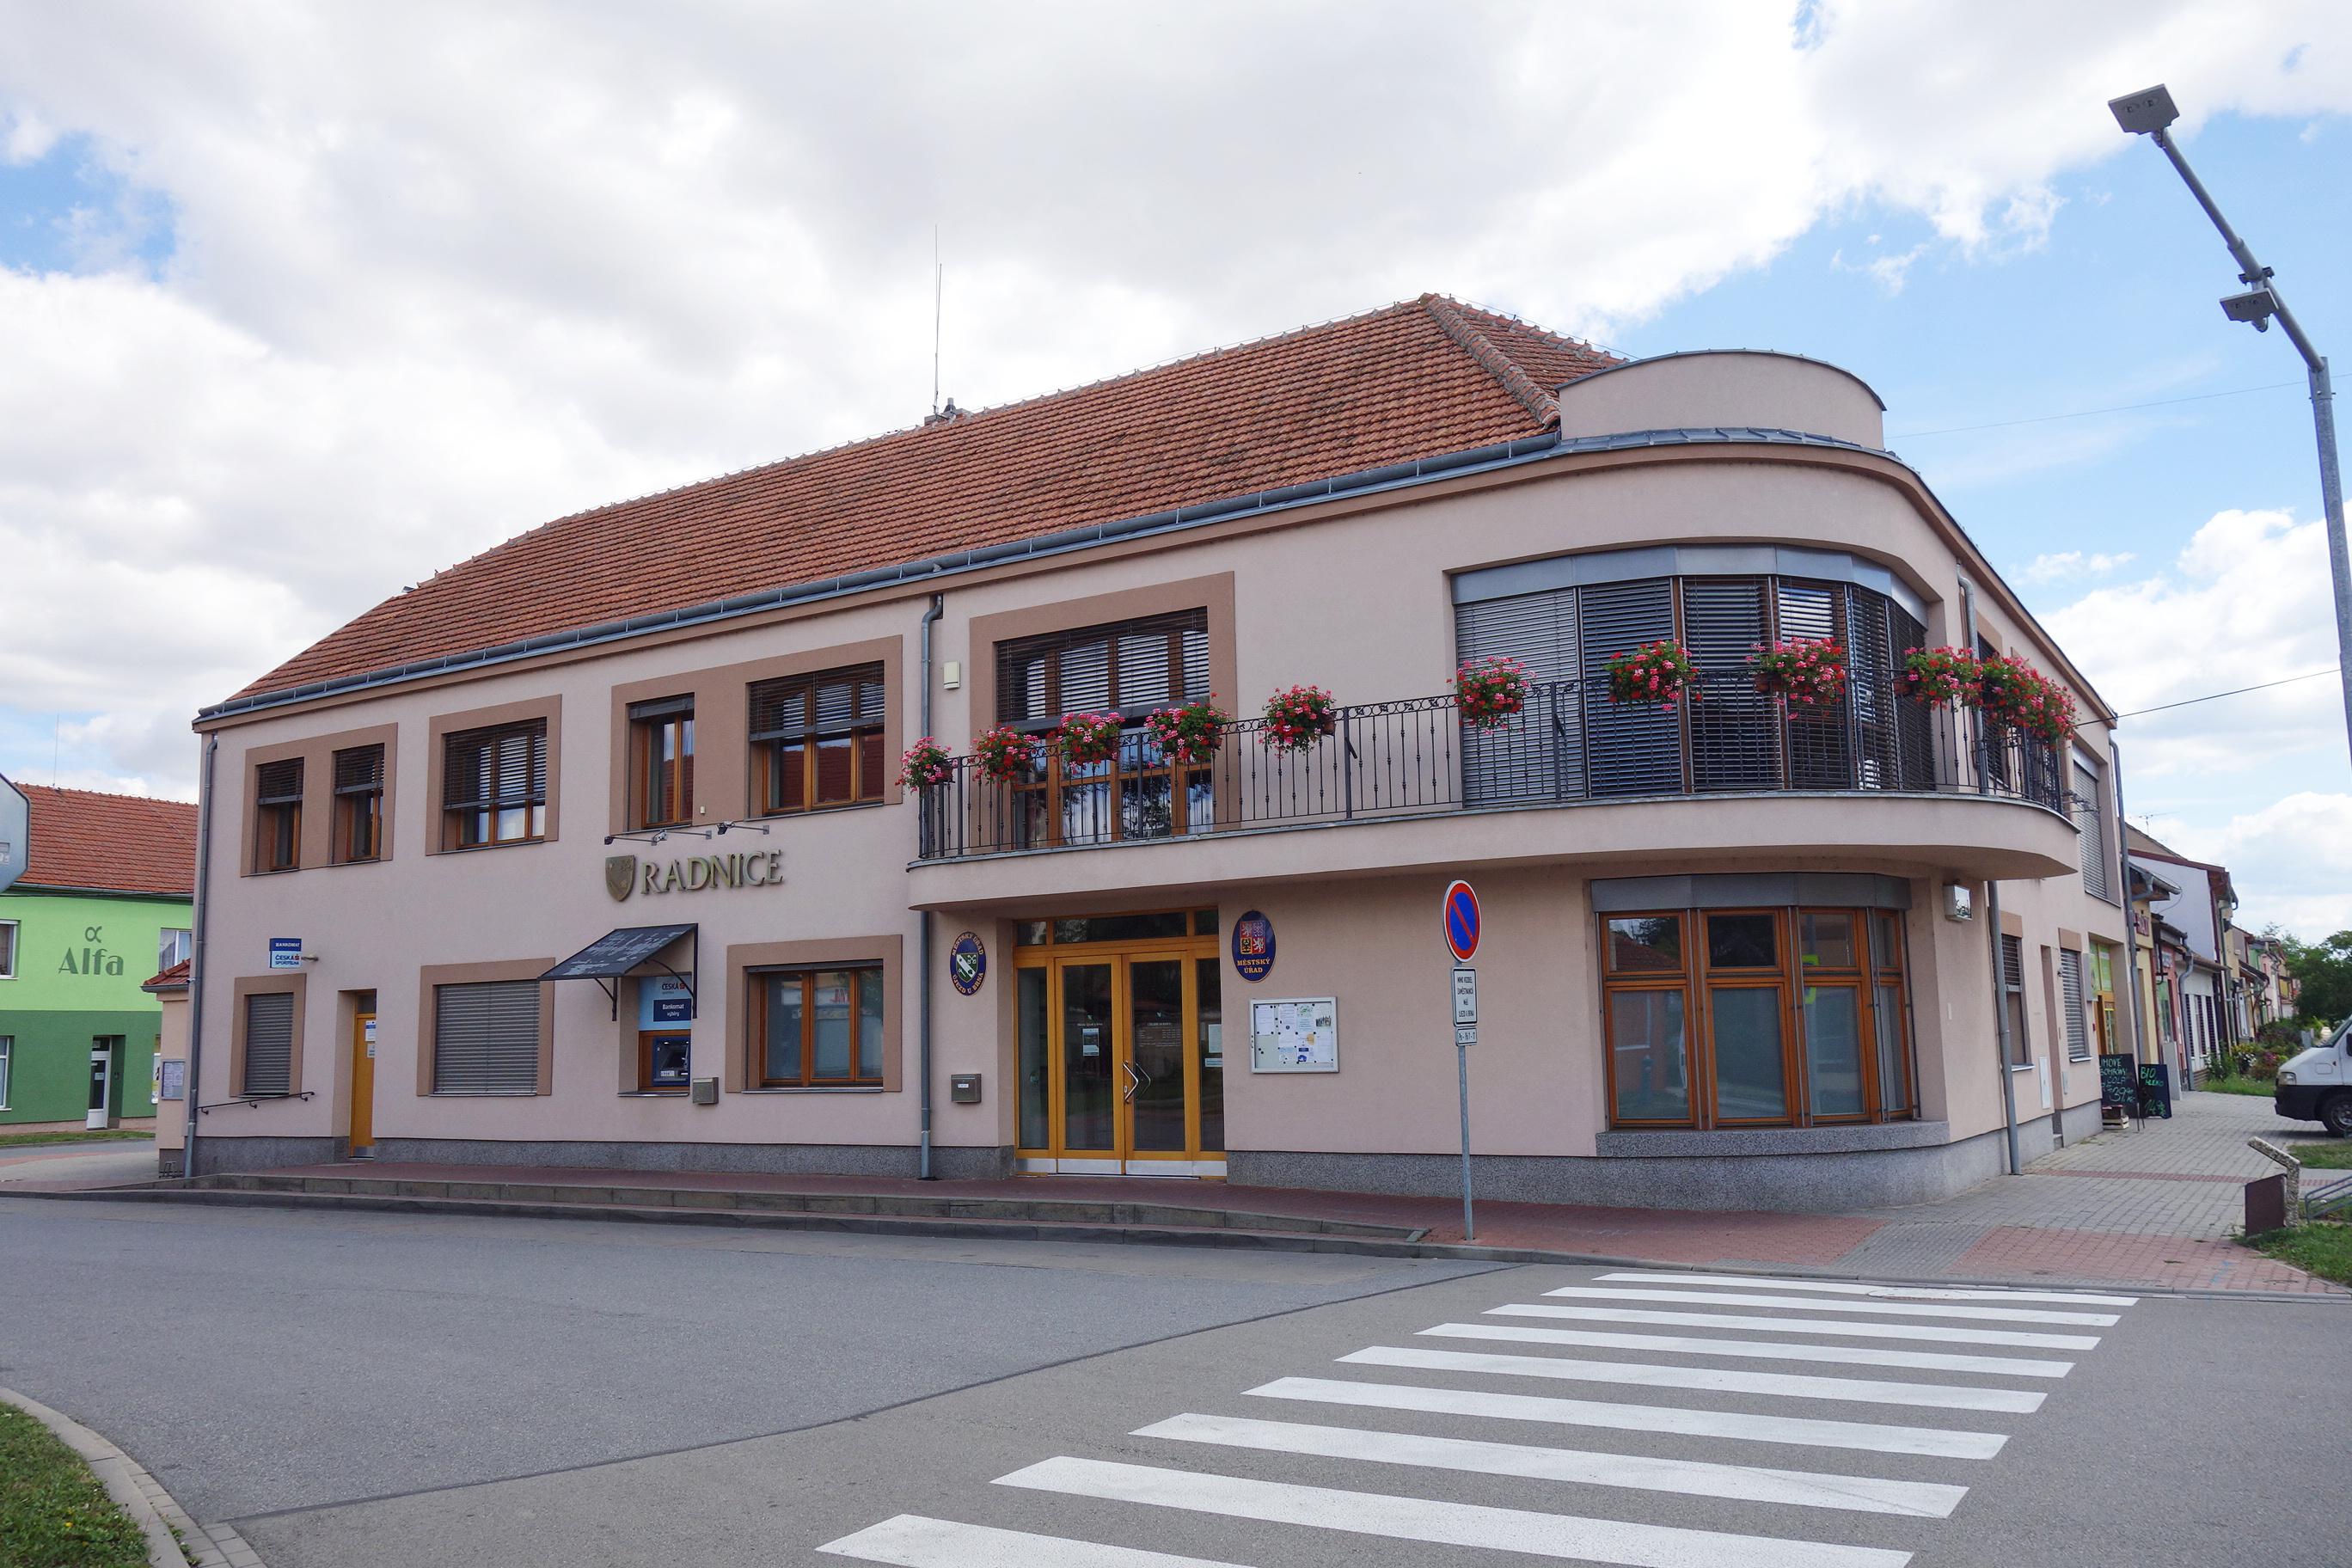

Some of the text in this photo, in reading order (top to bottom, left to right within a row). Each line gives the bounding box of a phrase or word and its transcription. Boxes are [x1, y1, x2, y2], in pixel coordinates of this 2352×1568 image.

[640, 849, 783, 895] RADNICE
[58, 946, 125, 977] Alfa
[1237, 957, 1271, 966] MĚSTSKÝ
[1244, 965, 1263, 974] ÚŘAD
[661, 982, 679, 990] ČESKÁ
[2141, 1066, 2156, 1080] BIO
